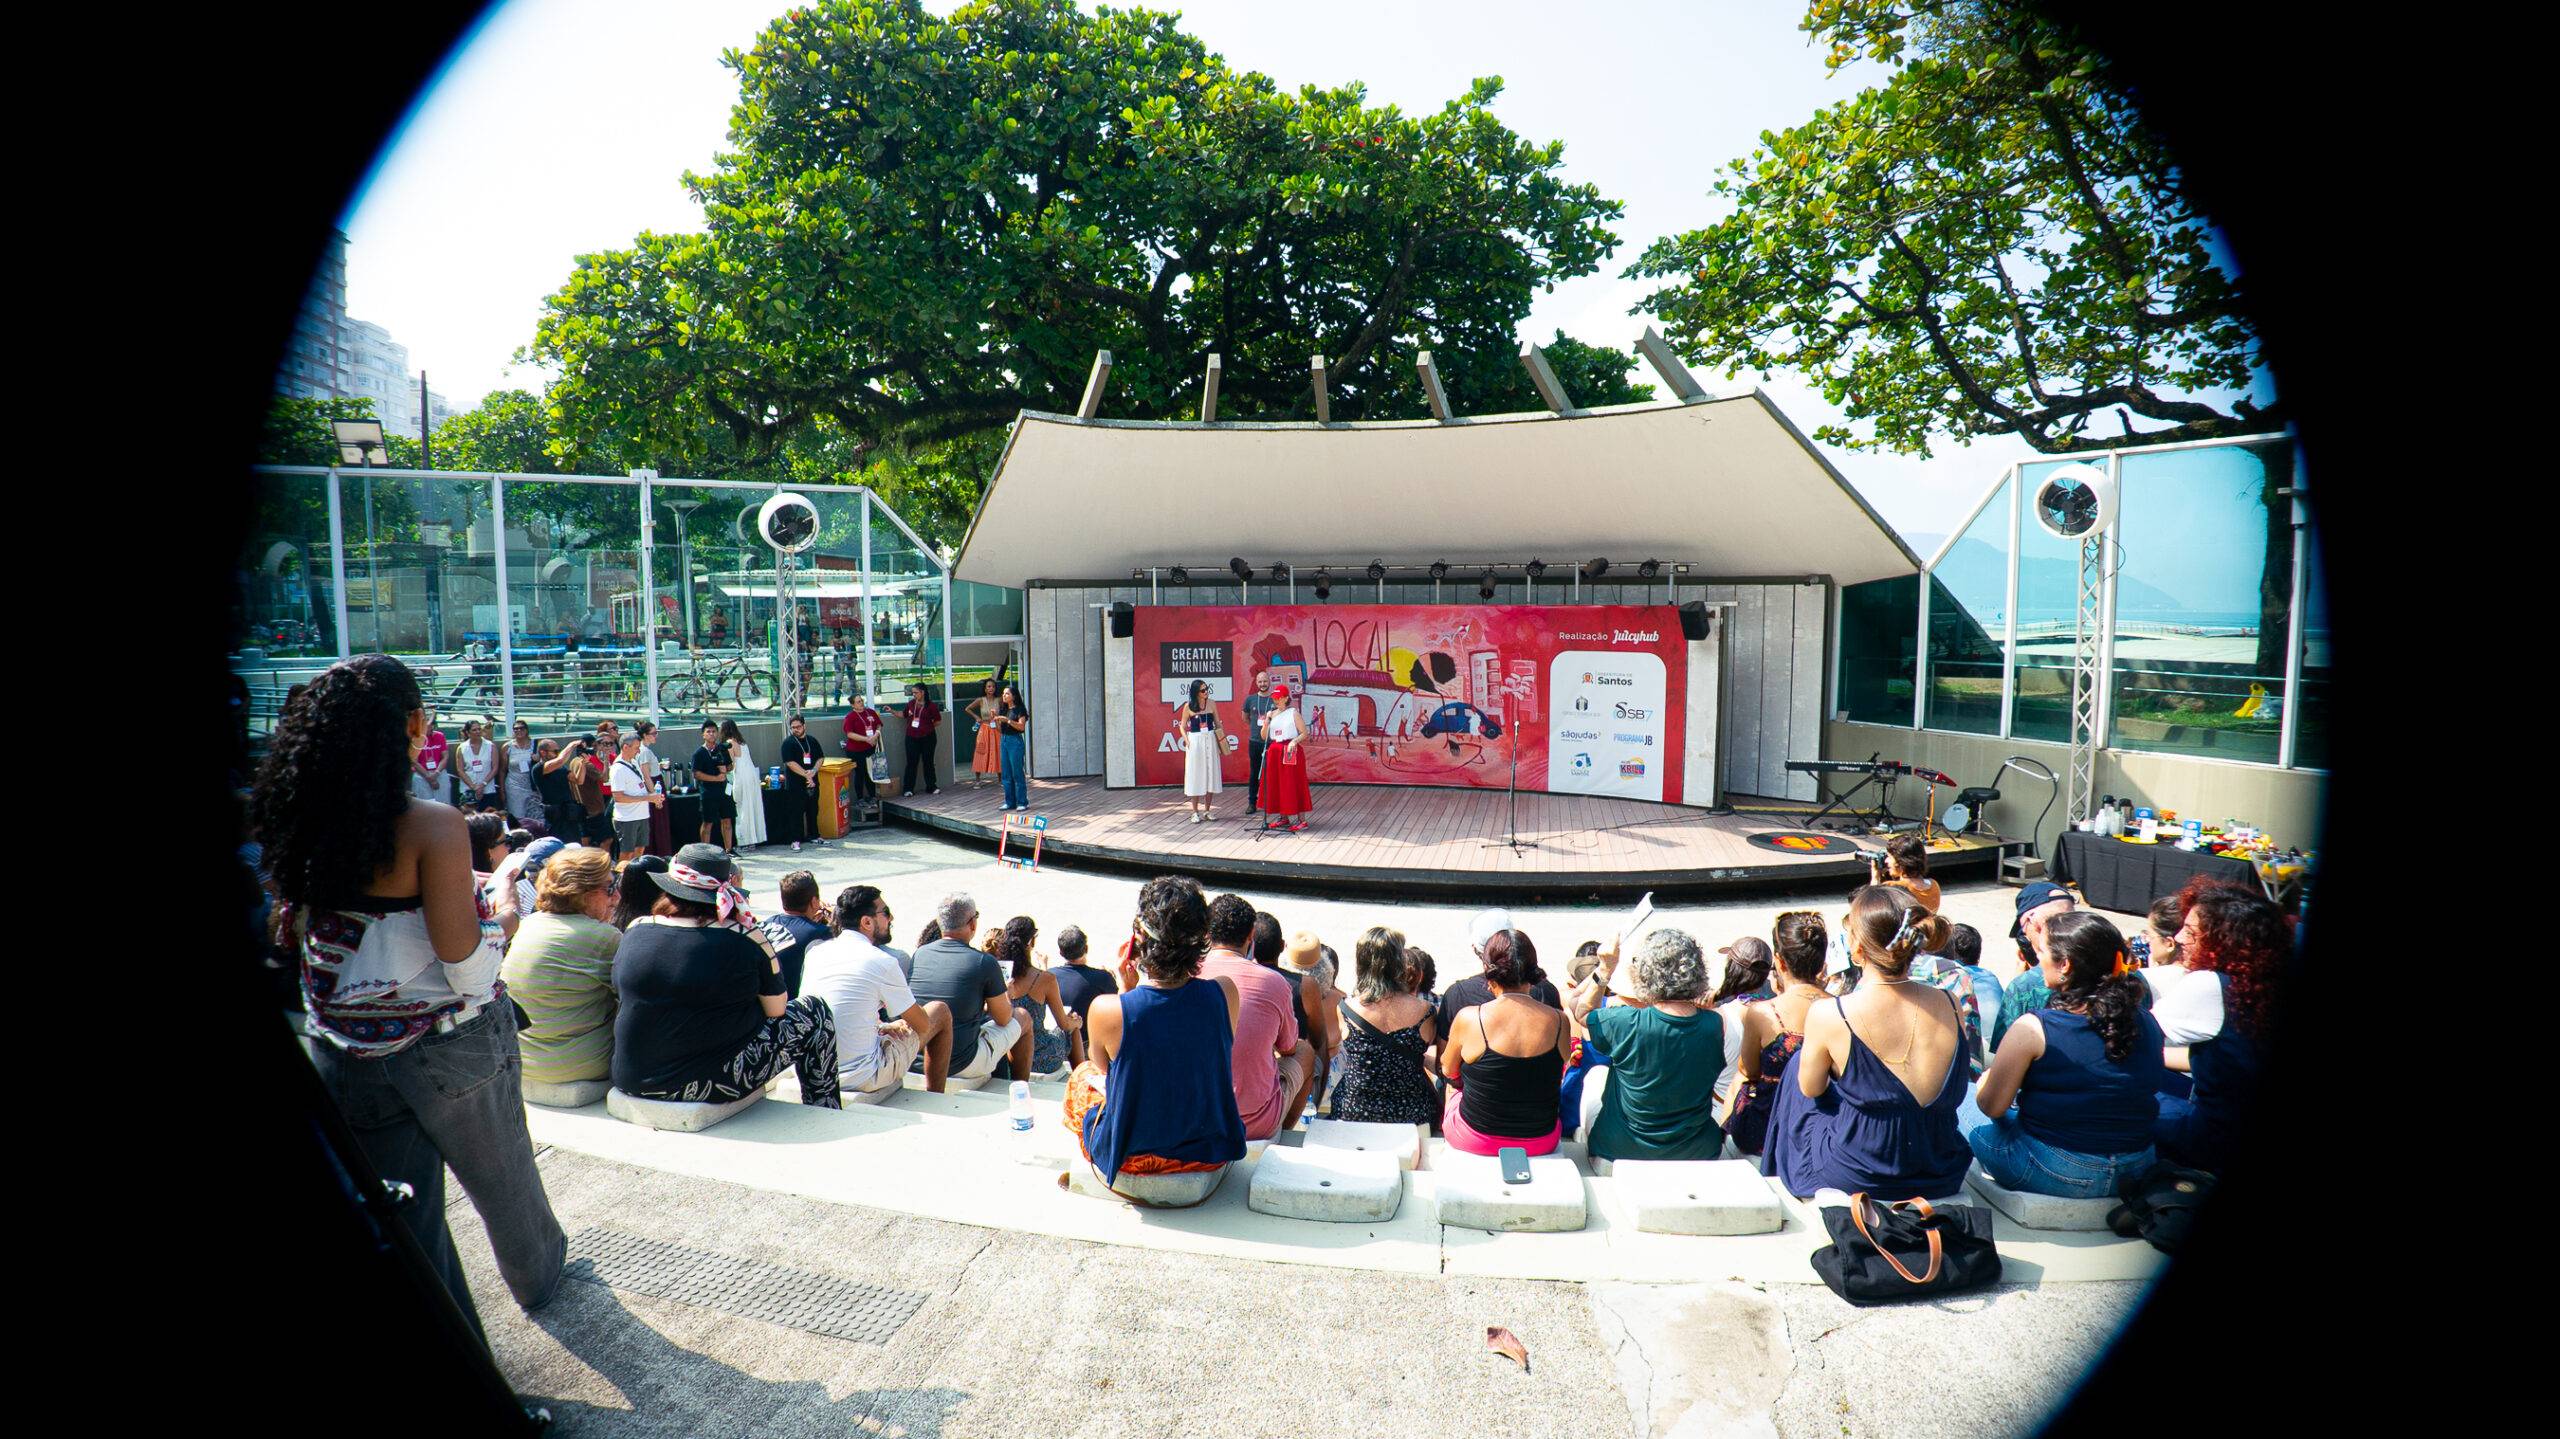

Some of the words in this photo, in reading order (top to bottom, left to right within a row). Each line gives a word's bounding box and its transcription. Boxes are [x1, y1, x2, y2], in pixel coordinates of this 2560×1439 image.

[1559, 632, 1608, 643] Realização
[1313, 618, 1394, 673] LOCAL
[1171, 647, 1222, 661] CREATIVE
[1171, 660, 1222, 673] MORNINGS
[1597, 676, 1633, 686] Santos
[1644, 735, 1653, 746] JB
